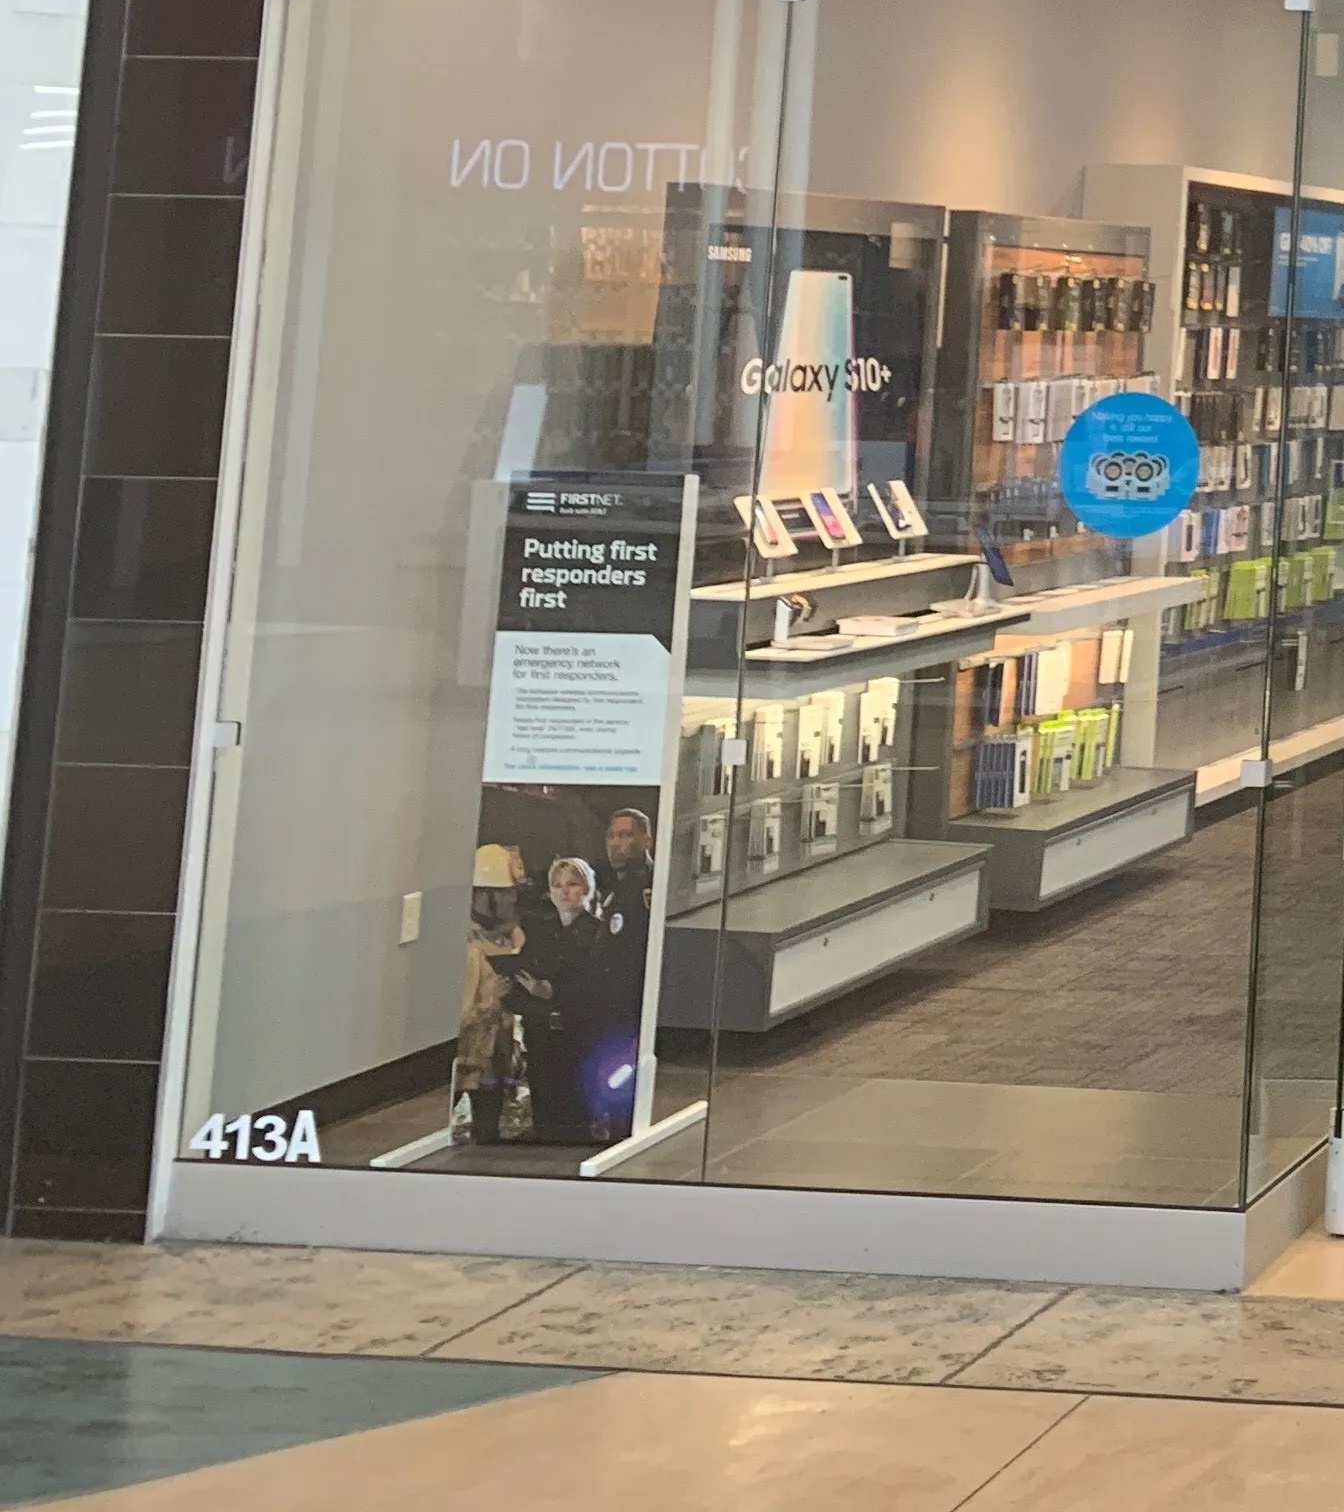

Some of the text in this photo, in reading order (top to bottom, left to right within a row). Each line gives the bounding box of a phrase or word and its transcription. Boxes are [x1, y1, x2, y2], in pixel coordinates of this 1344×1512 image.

[708, 245, 753, 263] SAMSUNG
[741, 357, 892, 402] Galaxy S10+
[524, 538, 658, 564] Putting first
[521, 565, 647, 587] responders
[519, 587, 568, 609] first
[515, 645, 596, 656] Now there's an
[513, 658, 621, 669] emergency network
[513, 669, 619, 681] for first responders.
[189, 1109, 322, 1163] 413A
